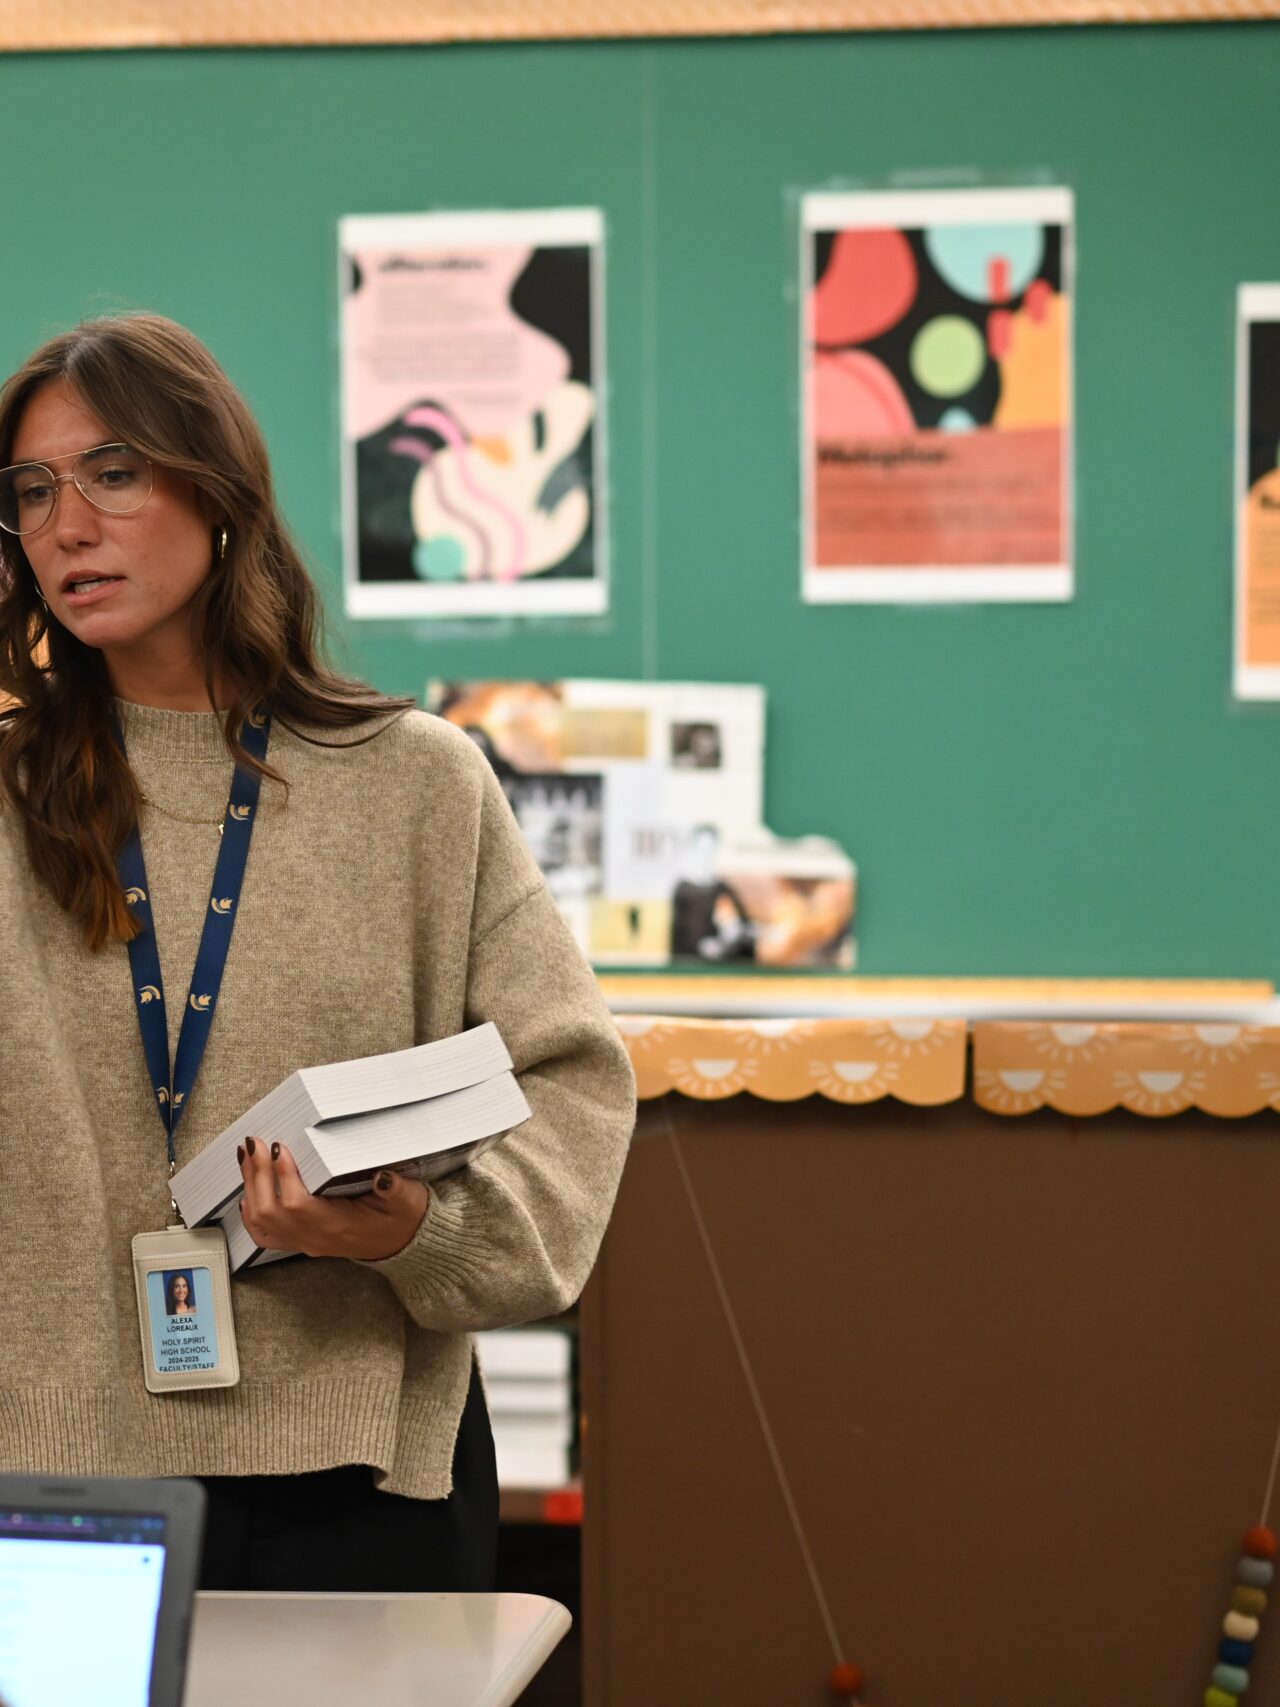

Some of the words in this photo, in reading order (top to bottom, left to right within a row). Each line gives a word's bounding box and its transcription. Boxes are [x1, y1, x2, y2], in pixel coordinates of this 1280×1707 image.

[167, 1324, 198, 1332] LOREAUX
[162, 1338, 181, 1346] HOLY
[183, 1336, 205, 1345] SPIRIT
[160, 1348, 179, 1356] HIGH
[180, 1346, 210, 1354] SCHOOL
[159, 1363, 215, 1372] FACULTY/STAFF
